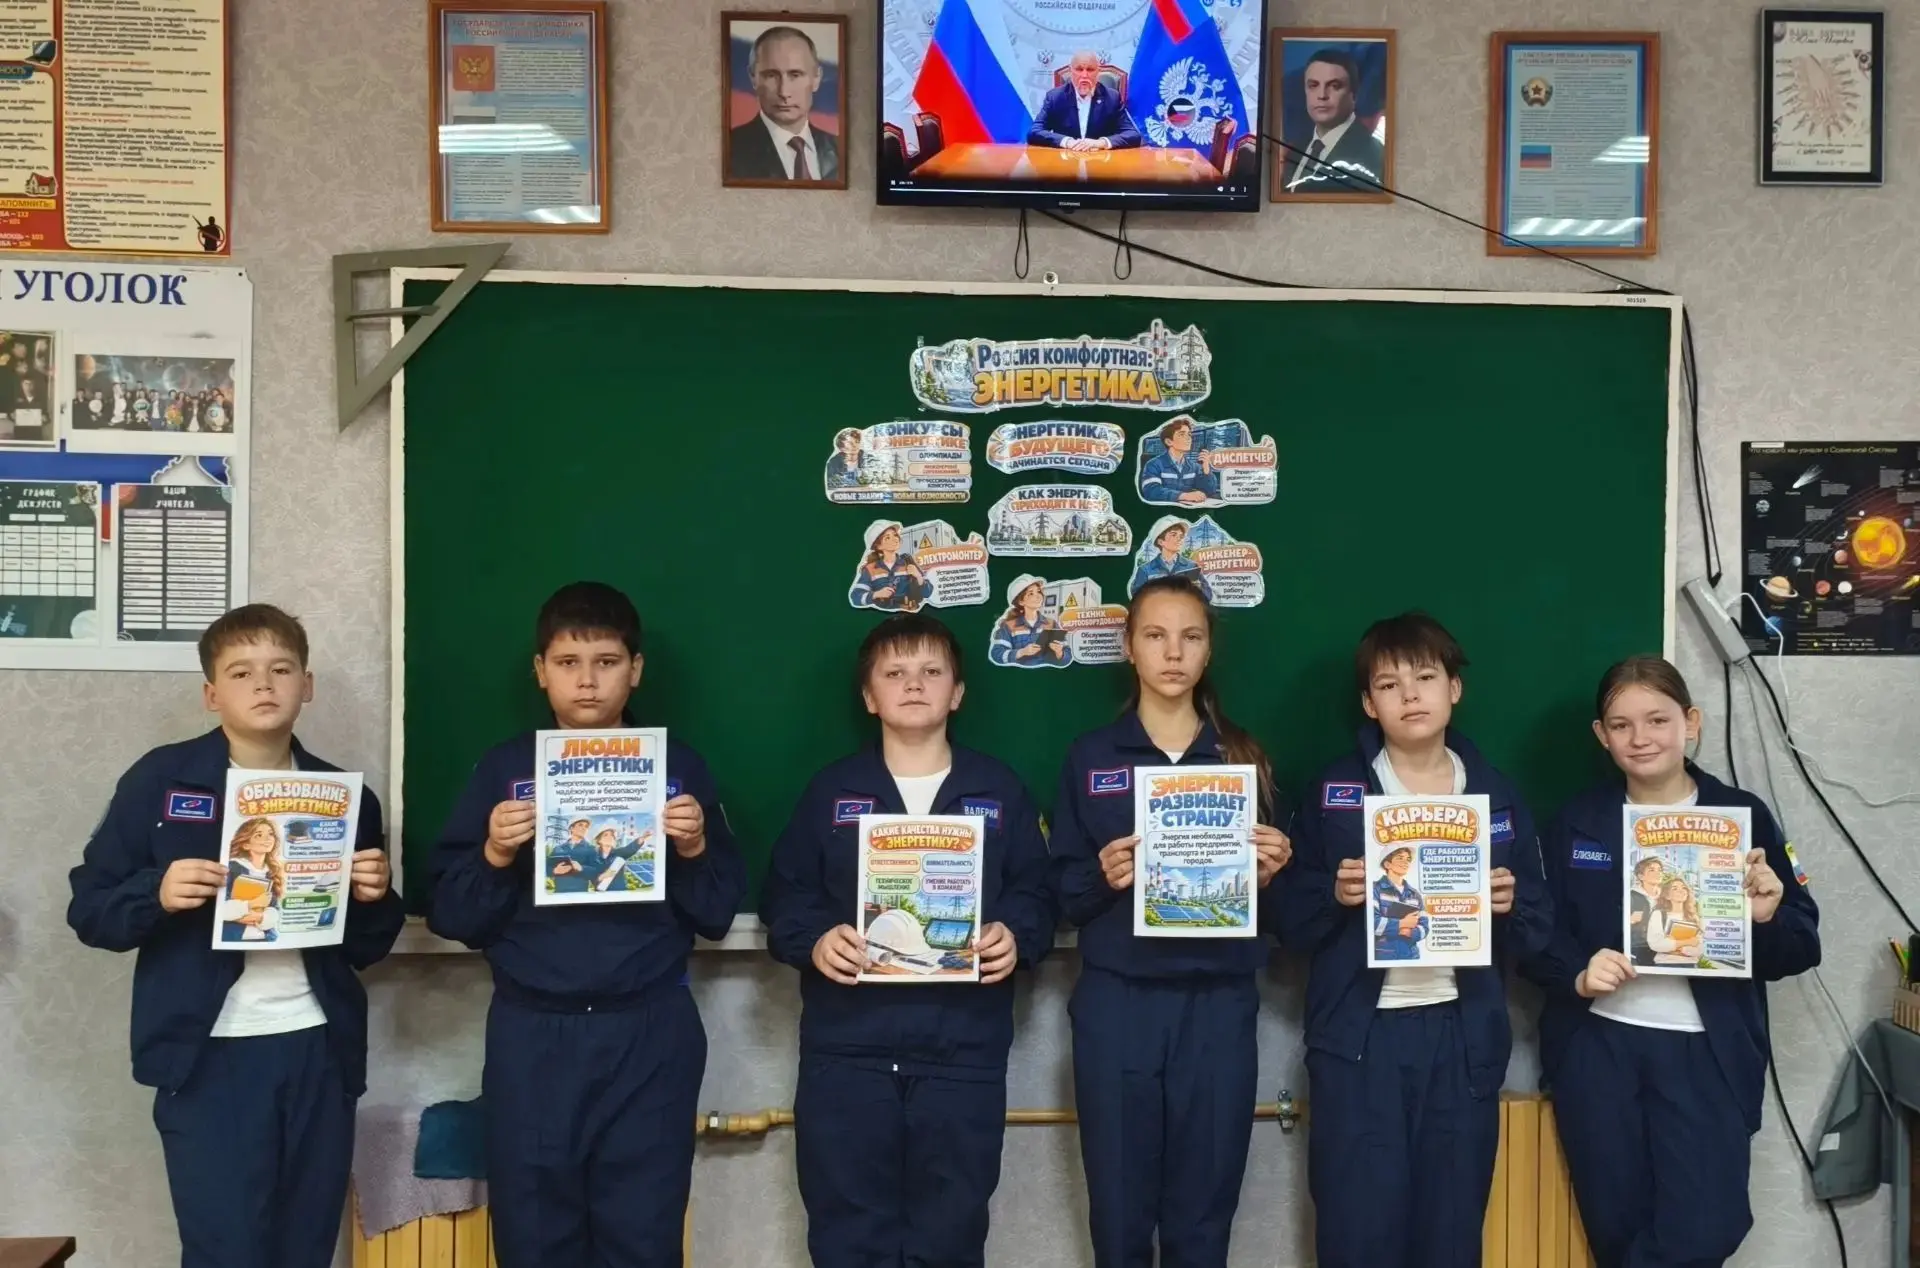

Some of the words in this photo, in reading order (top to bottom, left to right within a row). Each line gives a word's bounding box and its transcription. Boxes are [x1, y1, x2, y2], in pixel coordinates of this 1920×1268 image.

[0, 200, 53, 208] АПОМНИТЬ:
[14, 270, 188, 306] УГОЛОК
[977, 344, 1039, 368] Россия
[1042, 342, 1153, 369] комфортная:
[970, 368, 1162, 406] ЭНЕРГЕТИКА
[883, 435, 967, 450] НЕРГИКЕ
[1008, 437, 1112, 458] БУДУЩЕГО
[919, 452, 962, 460] ОЛИМПИАДЫ
[1213, 452, 1273, 466] ДИСПЕТЧЕР
[1007, 457, 1066, 469] НАЧИНАЕТСЯ
[1068, 457, 1110, 470] СЕГОДНЯ
[23, 488, 56, 497] ГРАФИК
[163, 486, 187, 495] НАШИ
[1018, 489, 1045, 500] КАК
[1047, 488, 1100, 500] ЭНЕРГИ
[16, 500, 62, 509] ДЕЖУРСТВ
[155, 499, 195, 509] УЧИТЕЛЯ
[1199, 548, 1252, 562] ИНЖЕНЕР-
[1203, 558, 1257, 570] ЭНЕРГЕТИК
[1077, 610, 1106, 618] ТЕХНИК
[560, 737, 641, 759] ЛЮДИ
[547, 757, 654, 777] ЭНЕРГЕТИКИ
[554, 780, 596, 788] Энергетики
[597, 779, 648, 787] обеспечивают
[1151, 776, 1244, 797] ЭНЕРГИЯ
[243, 782, 348, 802] ОБРАЗОВАНИЕ
[556, 787, 596, 796] надёжную
[604, 787, 648, 796] безопасную
[560, 796, 585, 804] работу
[588, 796, 643, 804] энергосистемы
[1149, 793, 1247, 813] РАЗВИВАЕТ
[248, 801, 258, 815] В
[262, 798, 340, 816] ЭНЕРГЕТИКЕ
[600, 804, 630, 812] страны.
[964, 805, 998, 818] ВАЛЕРИЙ
[1161, 809, 1235, 827] СТРАНУ
[1382, 807, 1469, 827] КАРЬЕРА
[871, 826, 900, 838] КАКИЕ
[901, 824, 940, 835] КАЧЕСТВА
[942, 826, 974, 838] НУЖНЫ
[1490, 820, 1511, 833] ОФЕЙ
[1646, 816, 1680, 831] КАК
[1683, 816, 1729, 833] СТАТЬ
[1161, 833, 1190, 841] Энергия
[1191, 832, 1234, 840] необходима
[1379, 829, 1389, 843] В
[1390, 823, 1475, 842] ЭНЕРГЕТИКЕ
[1639, 830, 1737, 849] ЭНЕРГЕТИКОМ?
[887, 836, 960, 849] ЭНЕРГЕТИКУ?
[1168, 841, 1194, 849] работы
[1195, 840, 1243, 848] предприятий,
[1159, 850, 1199, 858] транспорта
[1206, 849, 1238, 857] развития
[1423, 855, 1476, 863] ЭНЕРГЕТИКИ?
[1573, 850, 1612, 861] ЕЛИЗАВЕТА
[286, 863, 301, 872] ГДЕ
[302, 862, 341, 871] УЧИТЬСЯ?
[1183, 857, 1214, 865] городов.
[1434, 905, 1472, 913] КАРЬЕРУ?
